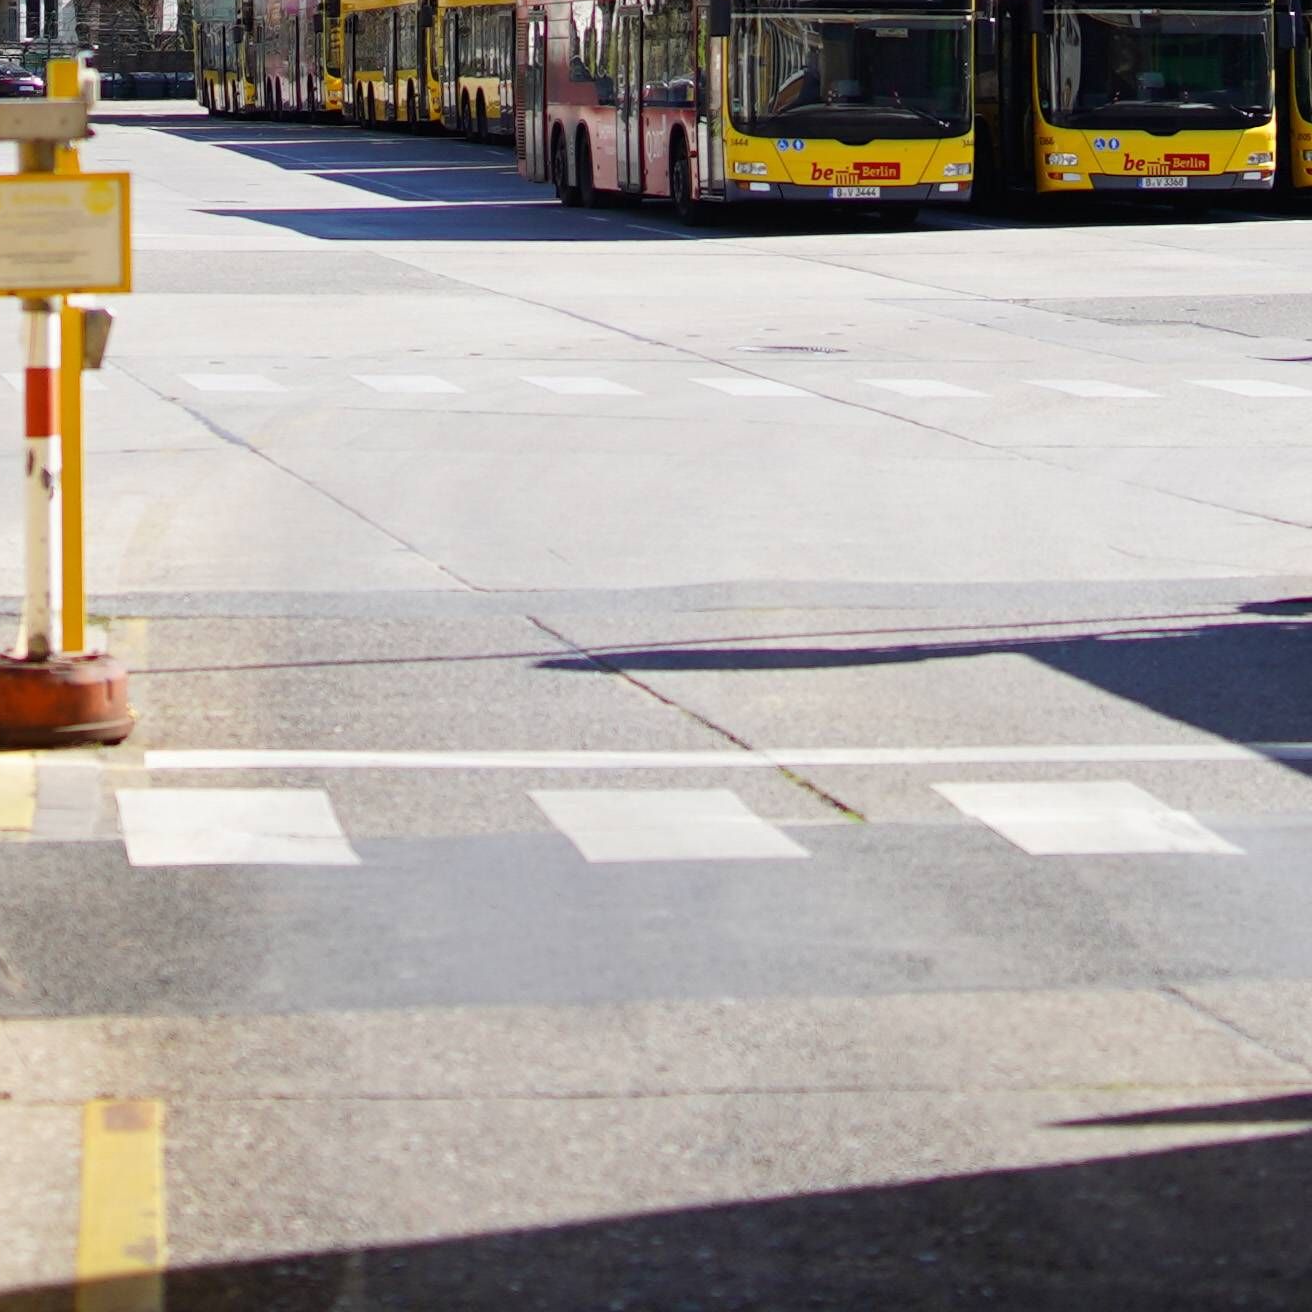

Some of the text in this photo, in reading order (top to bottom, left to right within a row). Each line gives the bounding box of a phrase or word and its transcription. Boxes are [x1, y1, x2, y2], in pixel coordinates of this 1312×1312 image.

[1123, 153, 1146, 172] be
[1172, 157, 1207, 170] Berlin
[811, 162, 834, 181] be
[862, 165, 898, 178] Berlin
